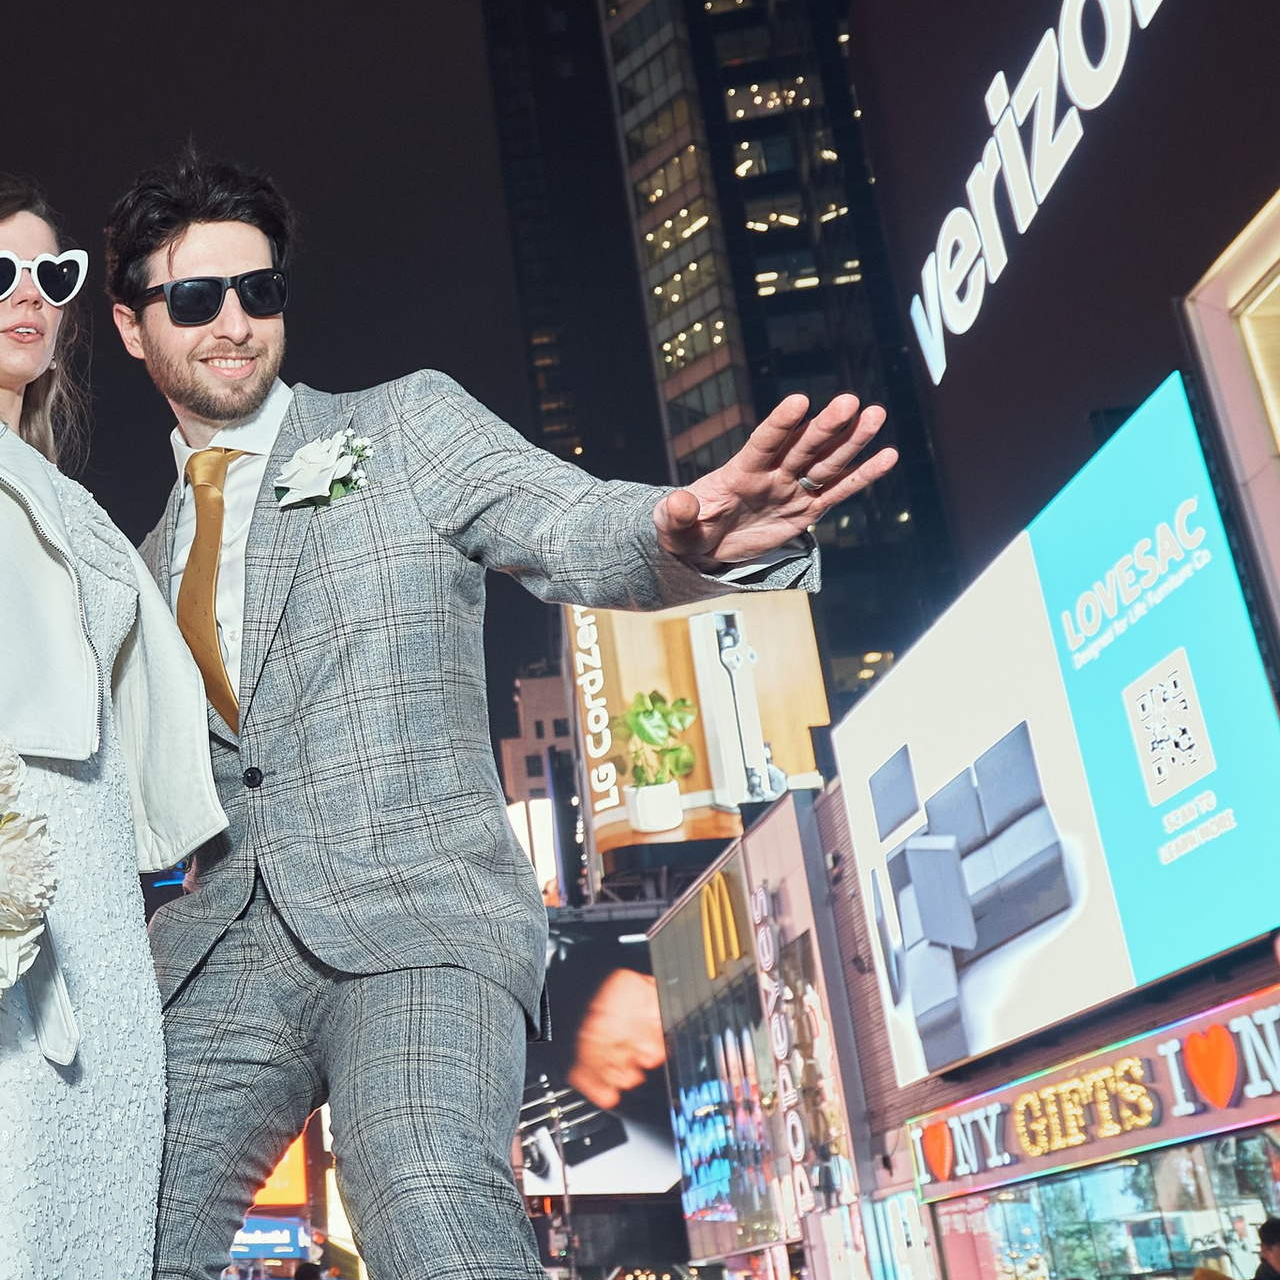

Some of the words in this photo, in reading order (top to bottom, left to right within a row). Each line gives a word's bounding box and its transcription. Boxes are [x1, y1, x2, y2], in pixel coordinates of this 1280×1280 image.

[1061, 497, 1207, 652] LOVESAC
[572, 605, 613, 759] CordZer
[591, 762, 620, 812] LG
[1015, 1056, 1155, 1158] GIFTS
